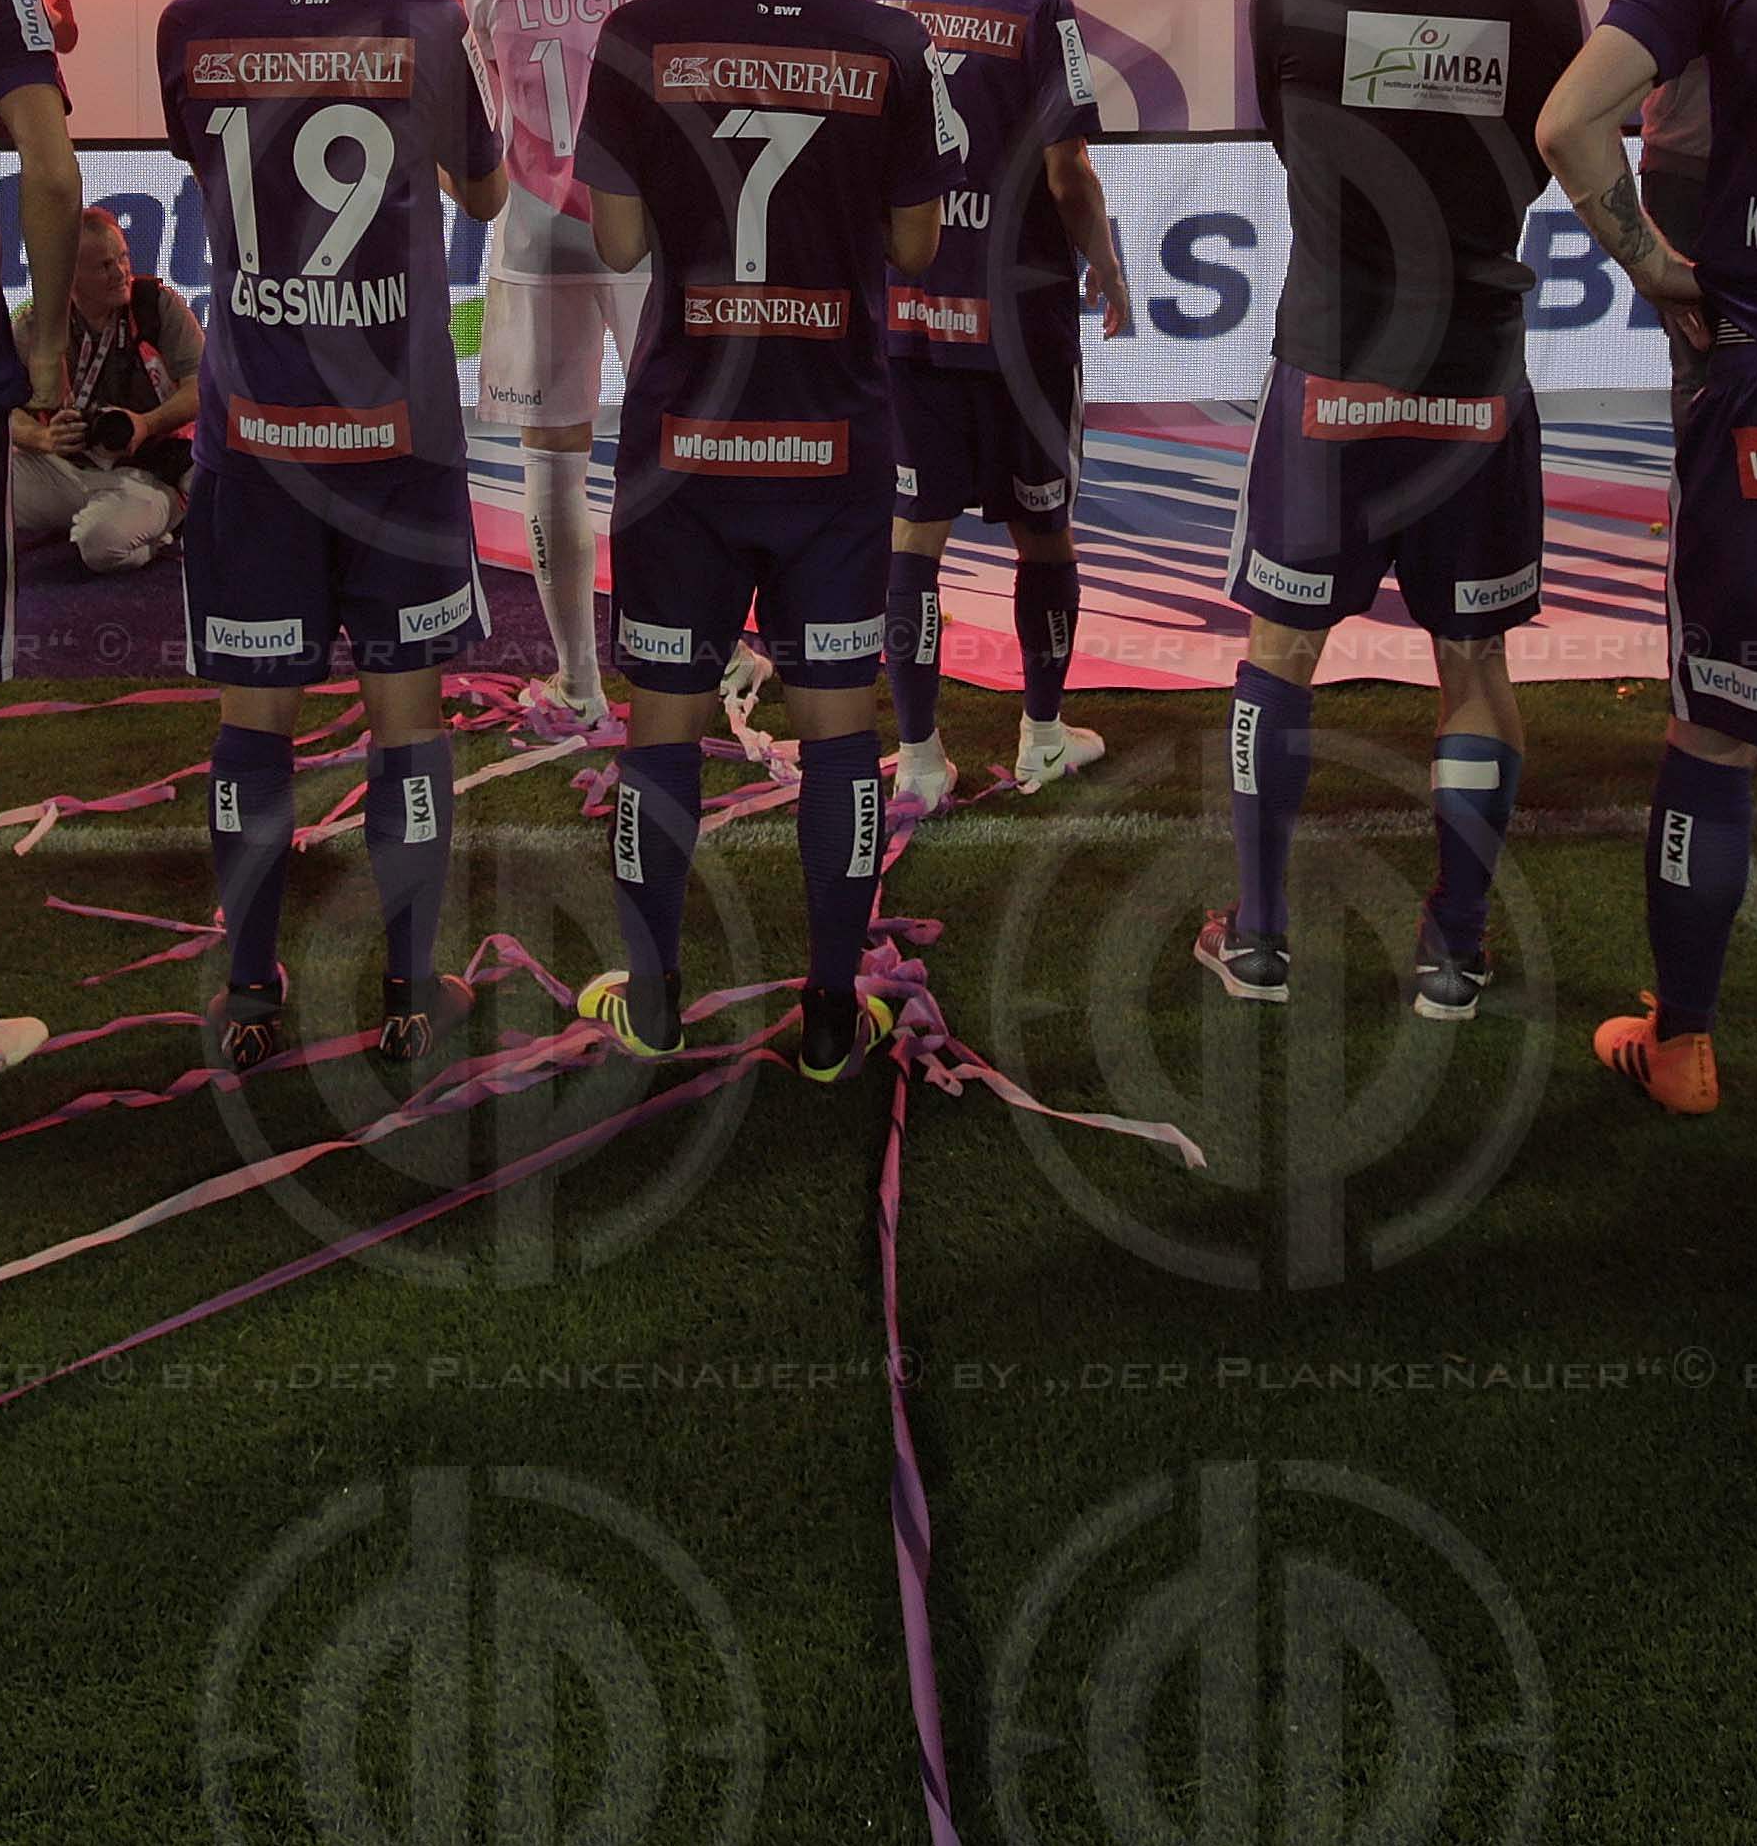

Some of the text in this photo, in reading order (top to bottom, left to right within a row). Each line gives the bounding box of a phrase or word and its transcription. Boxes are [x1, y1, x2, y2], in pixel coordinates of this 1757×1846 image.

[774, 4, 802, 17] BWT
[237, 51, 404, 85] GENERALI
[712, 55, 877, 103] GENERALI
[1067, 25, 1092, 102] Verbund
[1423, 53, 1503, 86] IMBA
[204, 103, 395, 276] 19
[710, 109, 826, 283] 7
[713, 296, 843, 329] GENERALI
[488, 383, 544, 409] Verbund
[1253, 559, 1327, 600] Verbund
[1463, 571, 1535, 608] Verbund
[211, 623, 298, 652] Verbund
[923, 594, 937, 650] KANDL
[1236, 704, 1255, 778] KANDL
[411, 778, 432, 825] KAN
[619, 789, 637, 861] KANDL
[858, 780, 877, 857] KANDL
[1666, 813, 1688, 865] KAN
